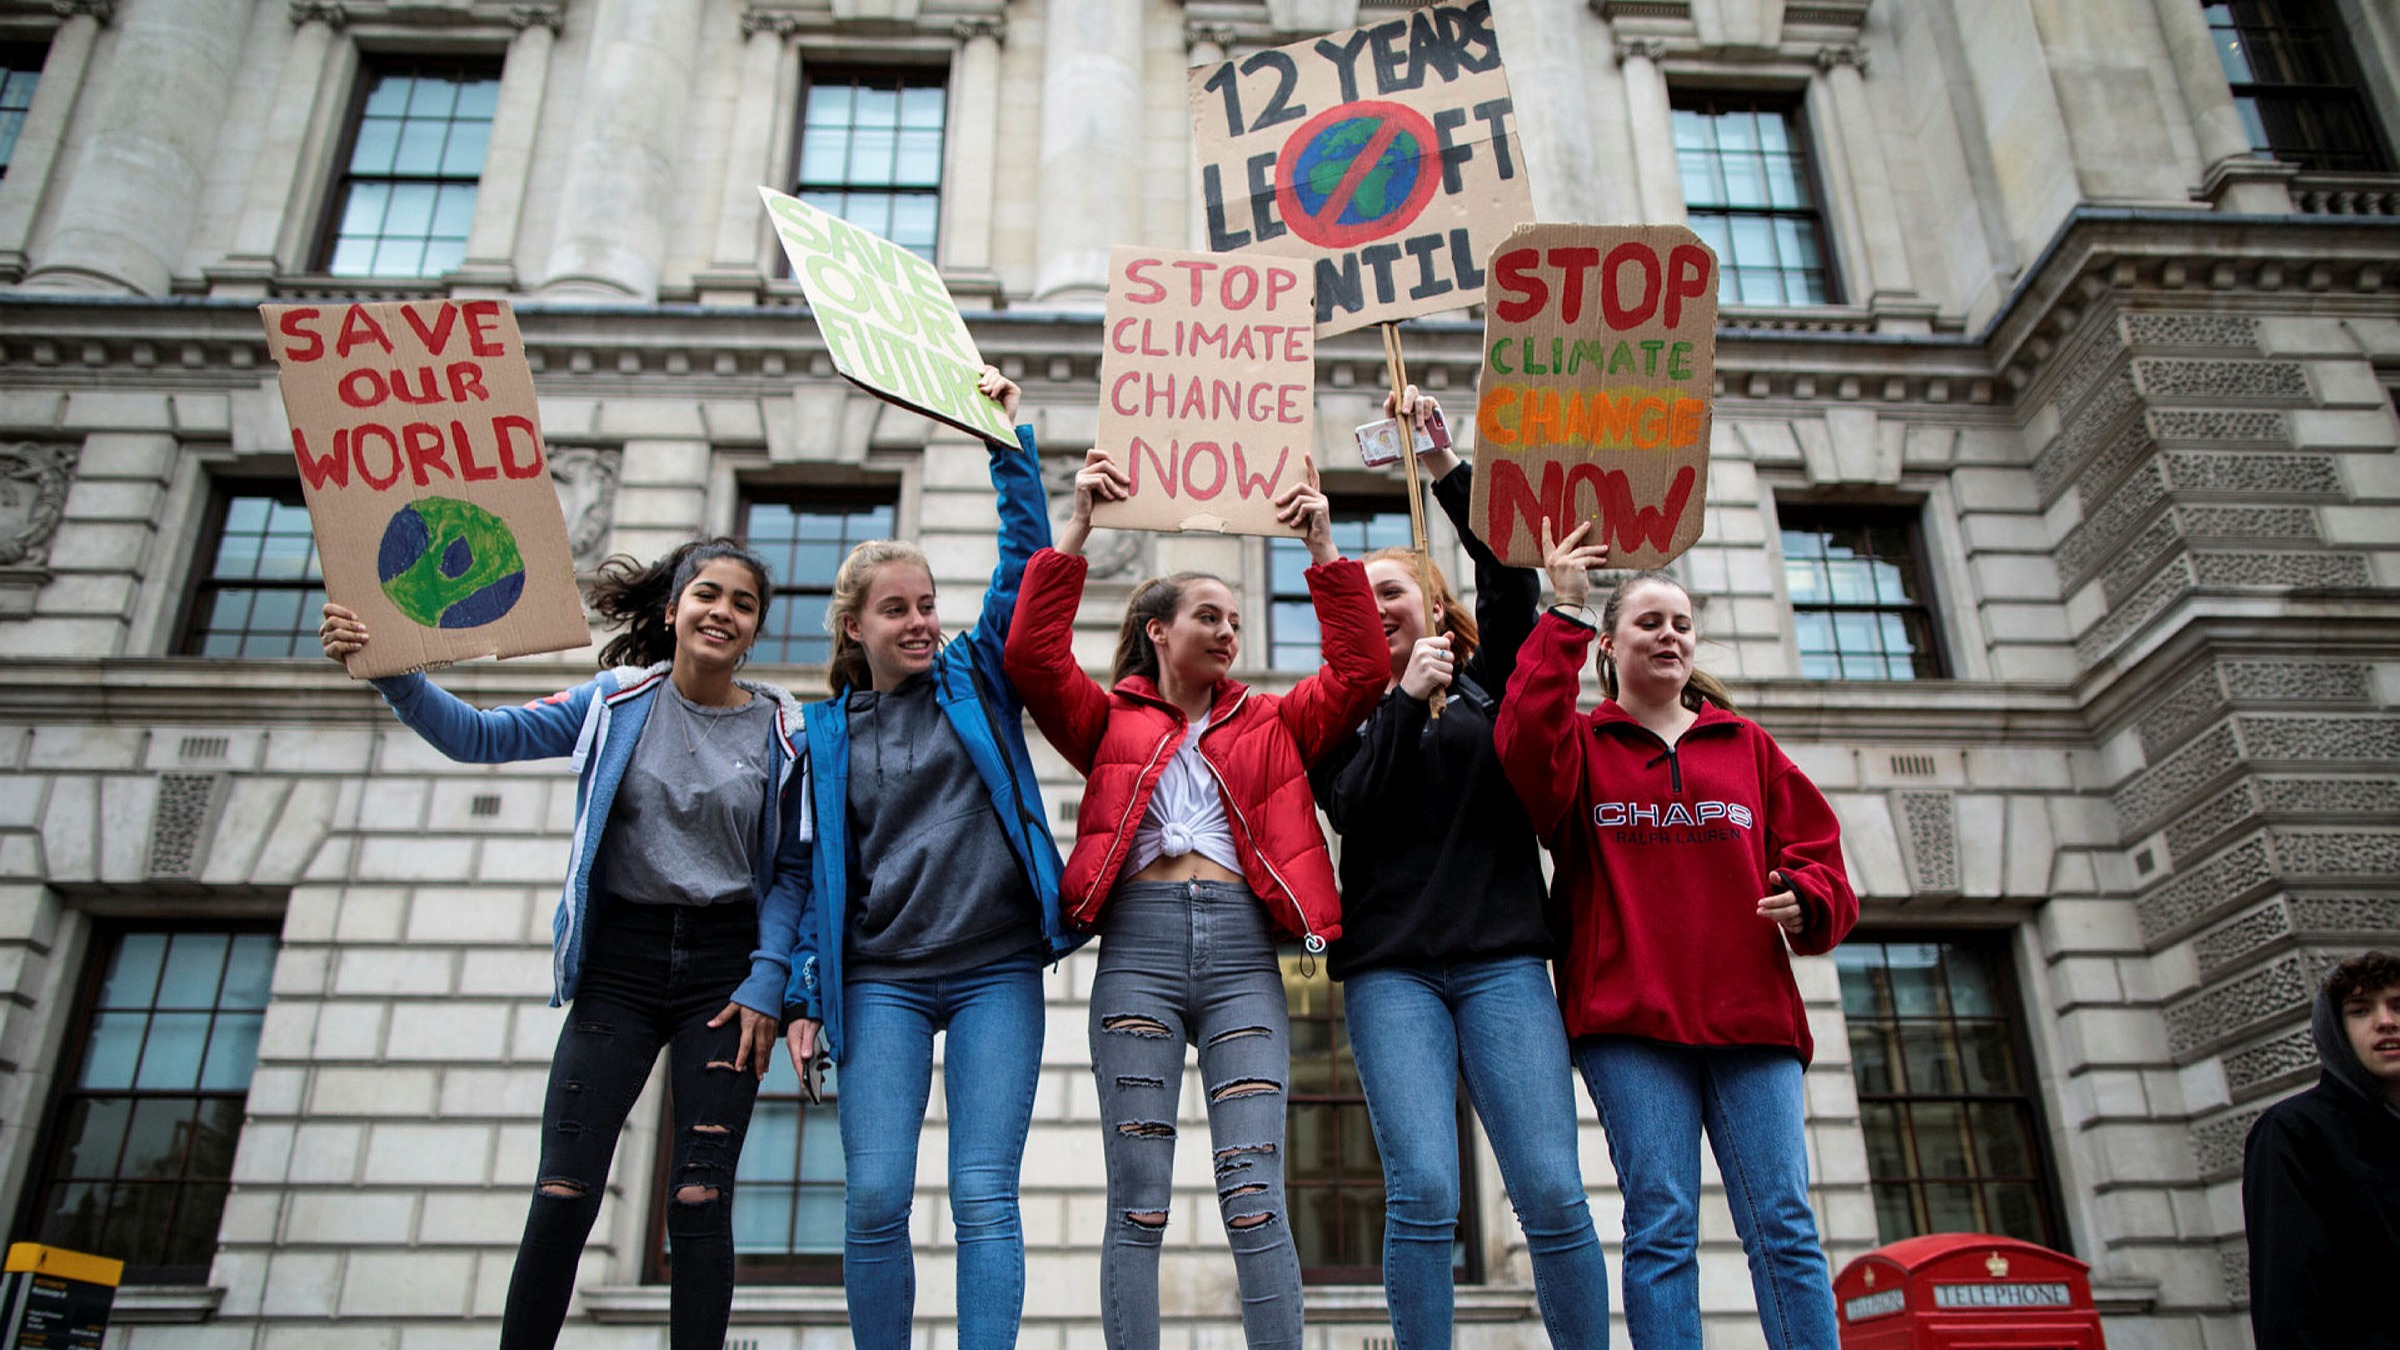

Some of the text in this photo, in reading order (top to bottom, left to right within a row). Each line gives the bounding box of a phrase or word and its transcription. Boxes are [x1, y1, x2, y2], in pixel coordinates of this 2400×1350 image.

[1204, 0, 1502, 138] 12 YEARS
[769, 196, 954, 313] SAVE
[1125, 259, 1297, 311] STOP
[1315, 228, 1485, 323] NTIL
[806, 255, 971, 363] OUR
[1495, 242, 1712, 331] STOP
[279, 301, 505, 362] SAVE
[1112, 317, 1312, 362] CLIMATE
[1490, 336, 1694, 381] CLIMATE
[338, 361, 490, 408] OUR
[1111, 371, 1307, 424] CHANGE
[1477, 386, 1705, 449] CHANGE
[292, 414, 544, 491] WORLD
[1128, 436, 1289, 501] NOW
[1488, 459, 1697, 561] NOW
[1594, 801, 1753, 829] CHAPS
[1616, 827, 1741, 845] RALPH LAUREN
[1939, 1284, 2064, 1306] TELEPHONE
